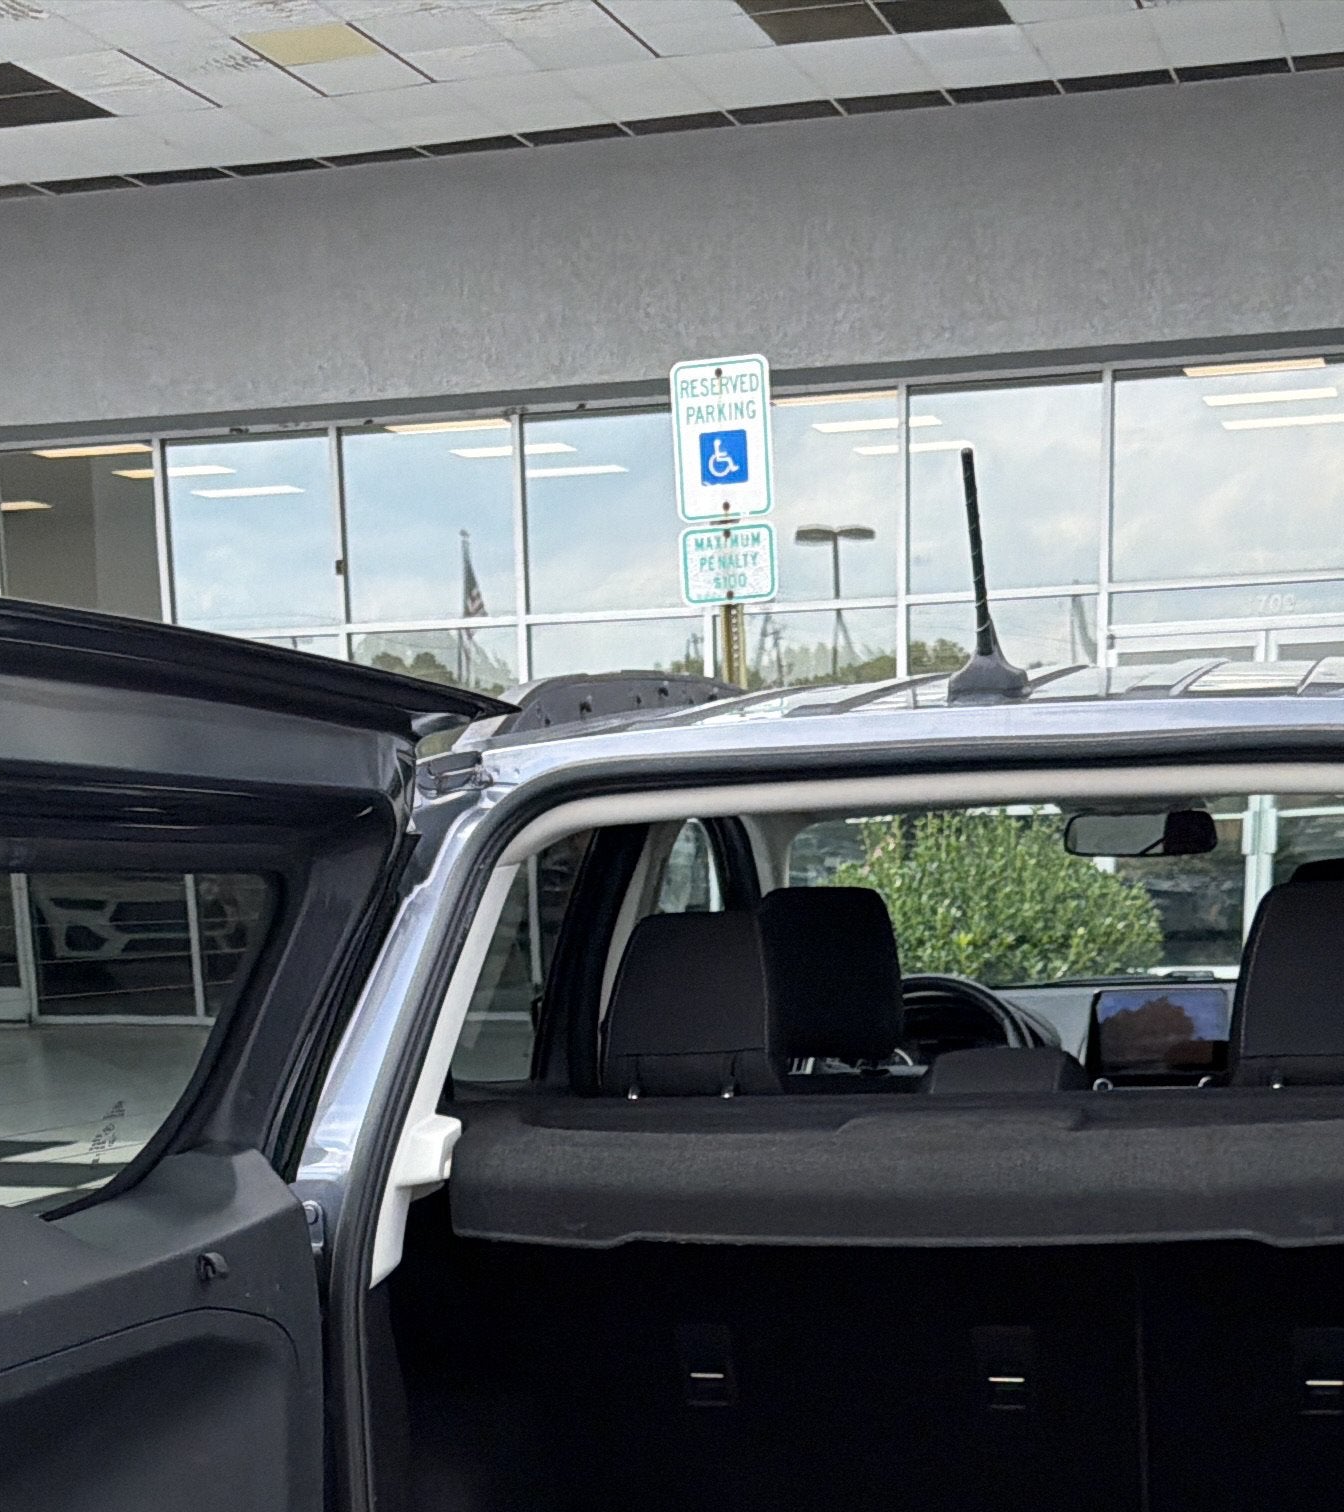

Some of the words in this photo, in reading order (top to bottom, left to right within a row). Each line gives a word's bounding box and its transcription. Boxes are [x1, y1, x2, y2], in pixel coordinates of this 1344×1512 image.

[680, 373, 759, 399] RESERVED
[686, 400, 757, 425] PARKING
[699, 551, 759, 572] PENALTY
[713, 573, 747, 589] $100
